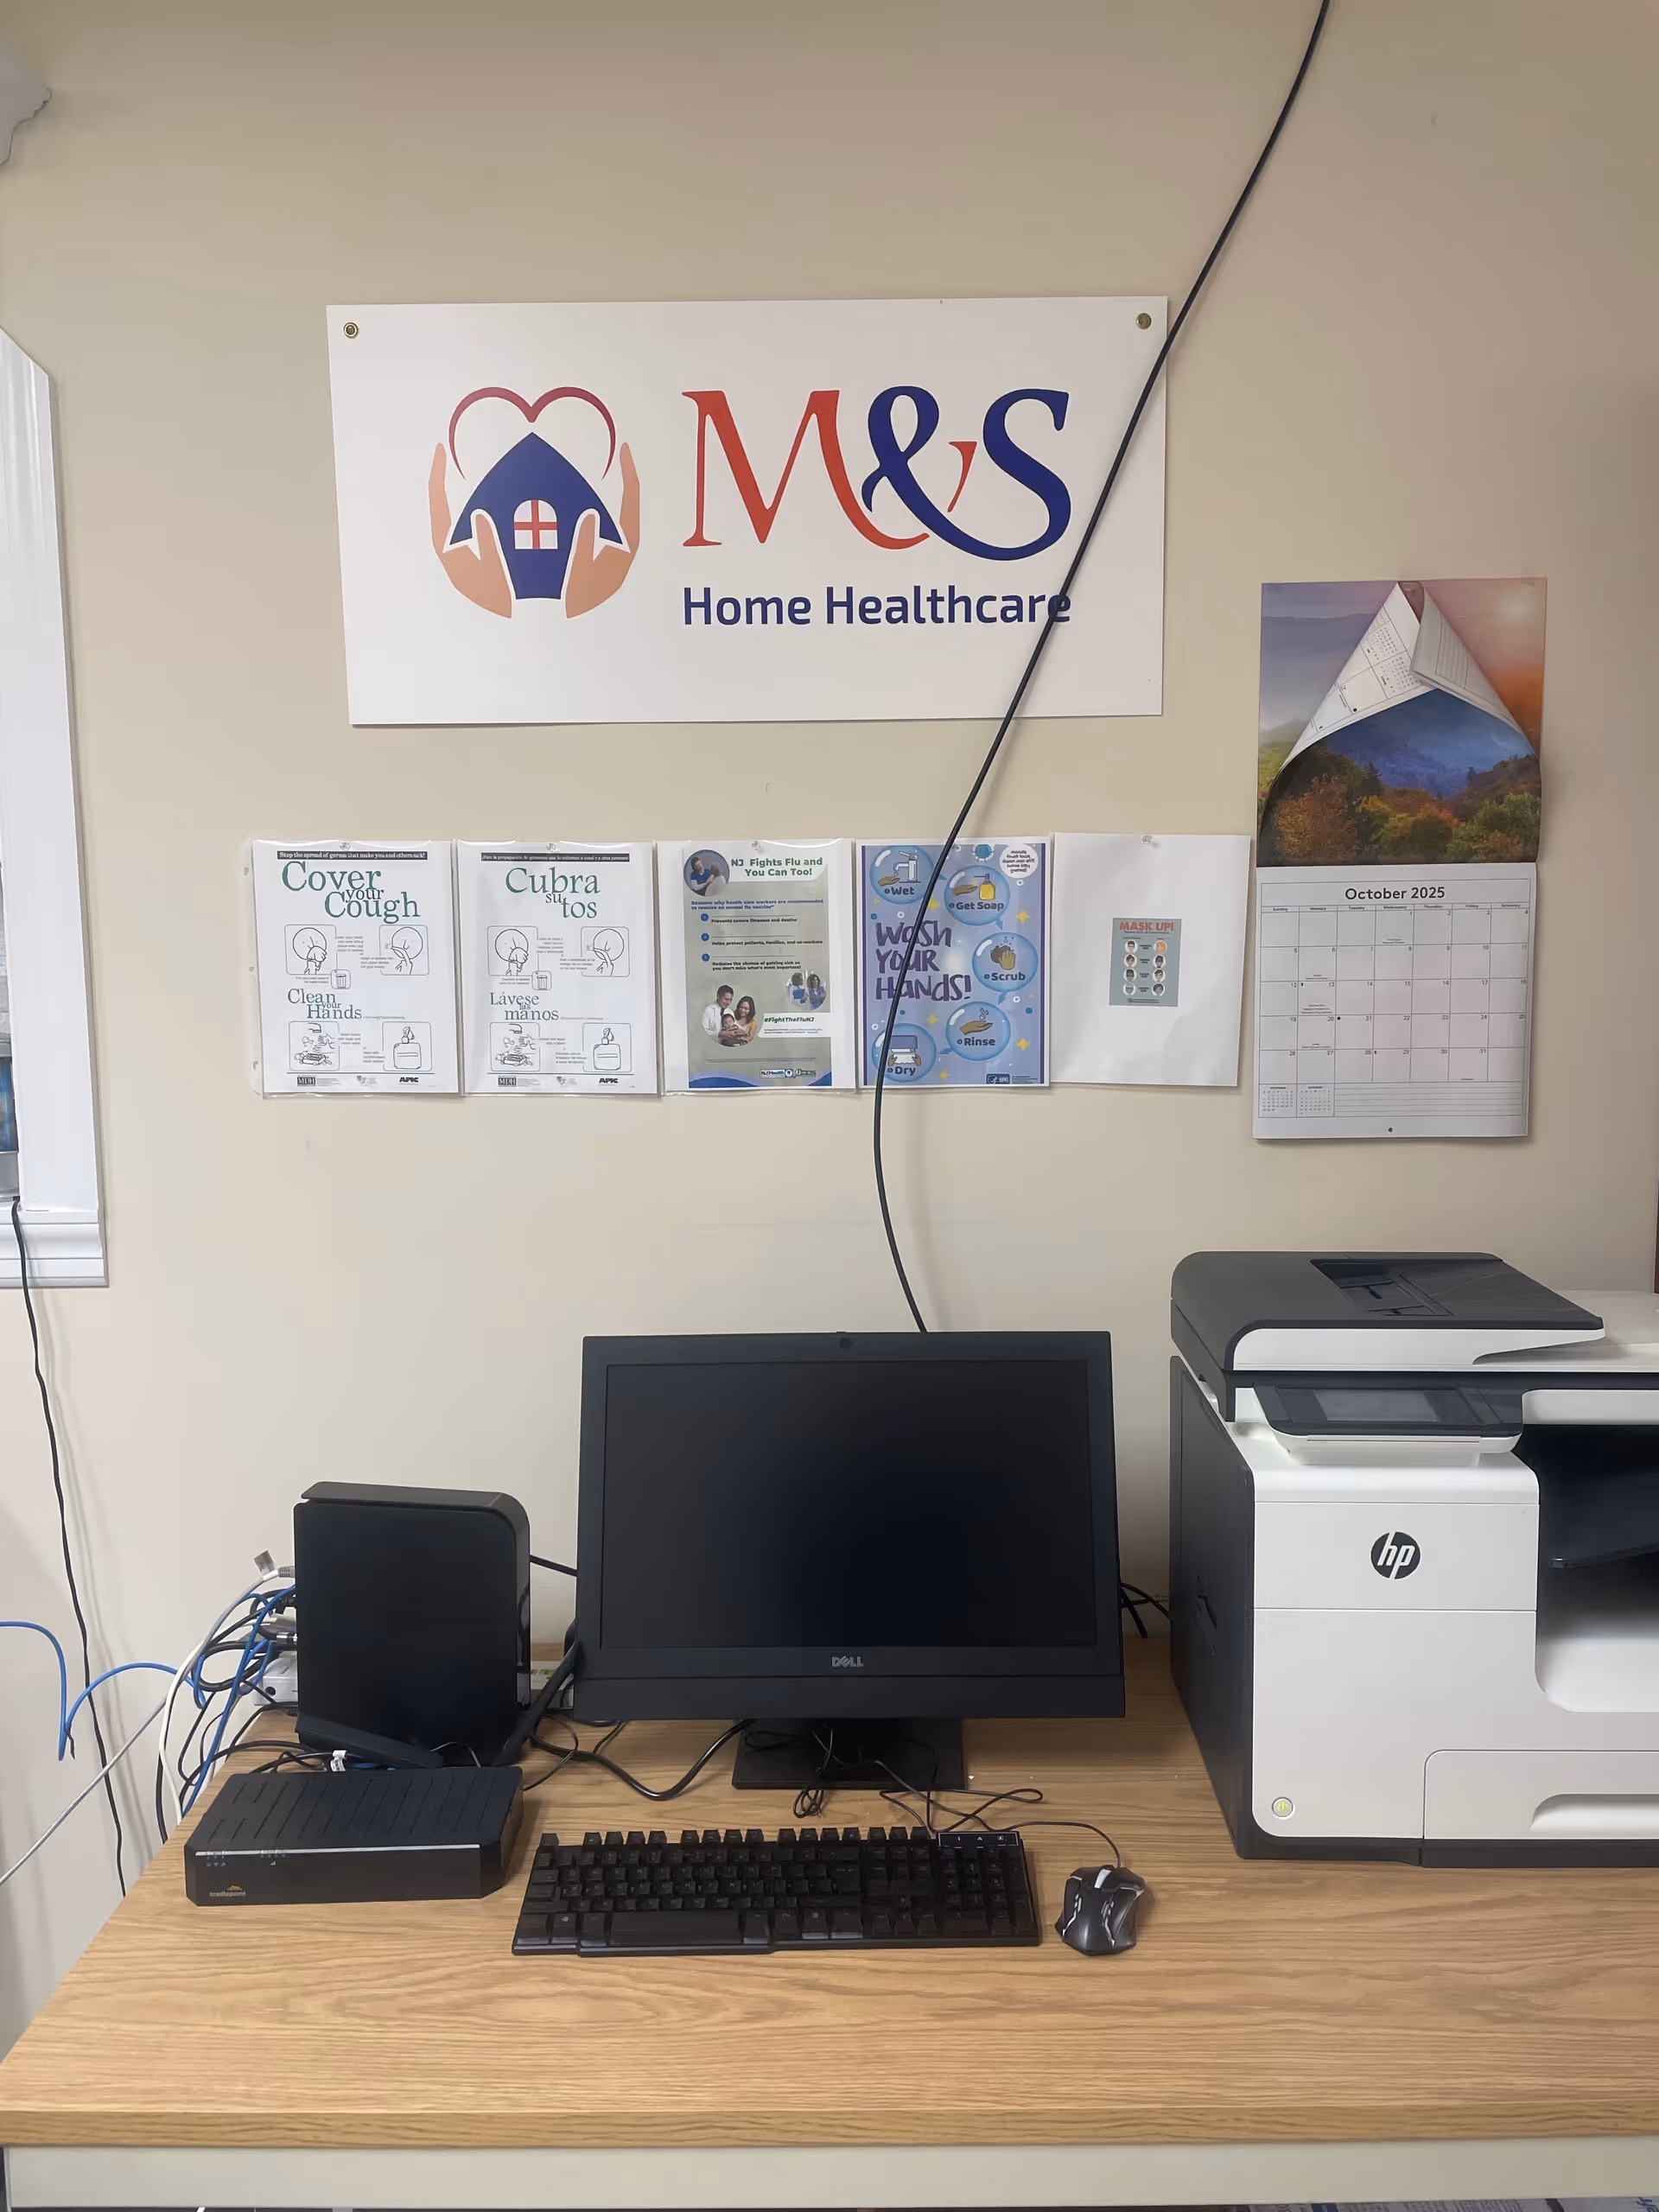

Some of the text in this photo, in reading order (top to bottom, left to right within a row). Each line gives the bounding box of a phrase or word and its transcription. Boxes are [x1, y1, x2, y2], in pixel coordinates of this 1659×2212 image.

[682, 385, 1071, 562] M&S
[683, 584, 1071, 626] Home Healthcare
[750, 858, 782, 868] Fights
[804, 857, 823, 866] and
[282, 861, 382, 892] Cover
[505, 866, 601, 894] Cubra
[346, 889, 384, 903] your
[891, 887, 915, 895] Wet
[1345, 887, 1446, 900] October 2025
[545, 893, 562, 903] su
[325, 891, 421, 924] Cough
[561, 897, 597, 918] tos
[977, 902, 1004, 912] Soap
[1120, 921, 1175, 931] MASK UP!
[991, 972, 1026, 982] Scrub
[287, 988, 336, 1004] Clean
[490, 992, 539, 1005] Lávese
[307, 1004, 362, 1019] Hands
[505, 1009, 559, 1020] manos
[964, 1037, 995, 1046] Rinse
[894, 1067, 916, 1076] Dry
[1377, 1532, 1415, 1580] hp
[832, 1656, 863, 1668] DELL
